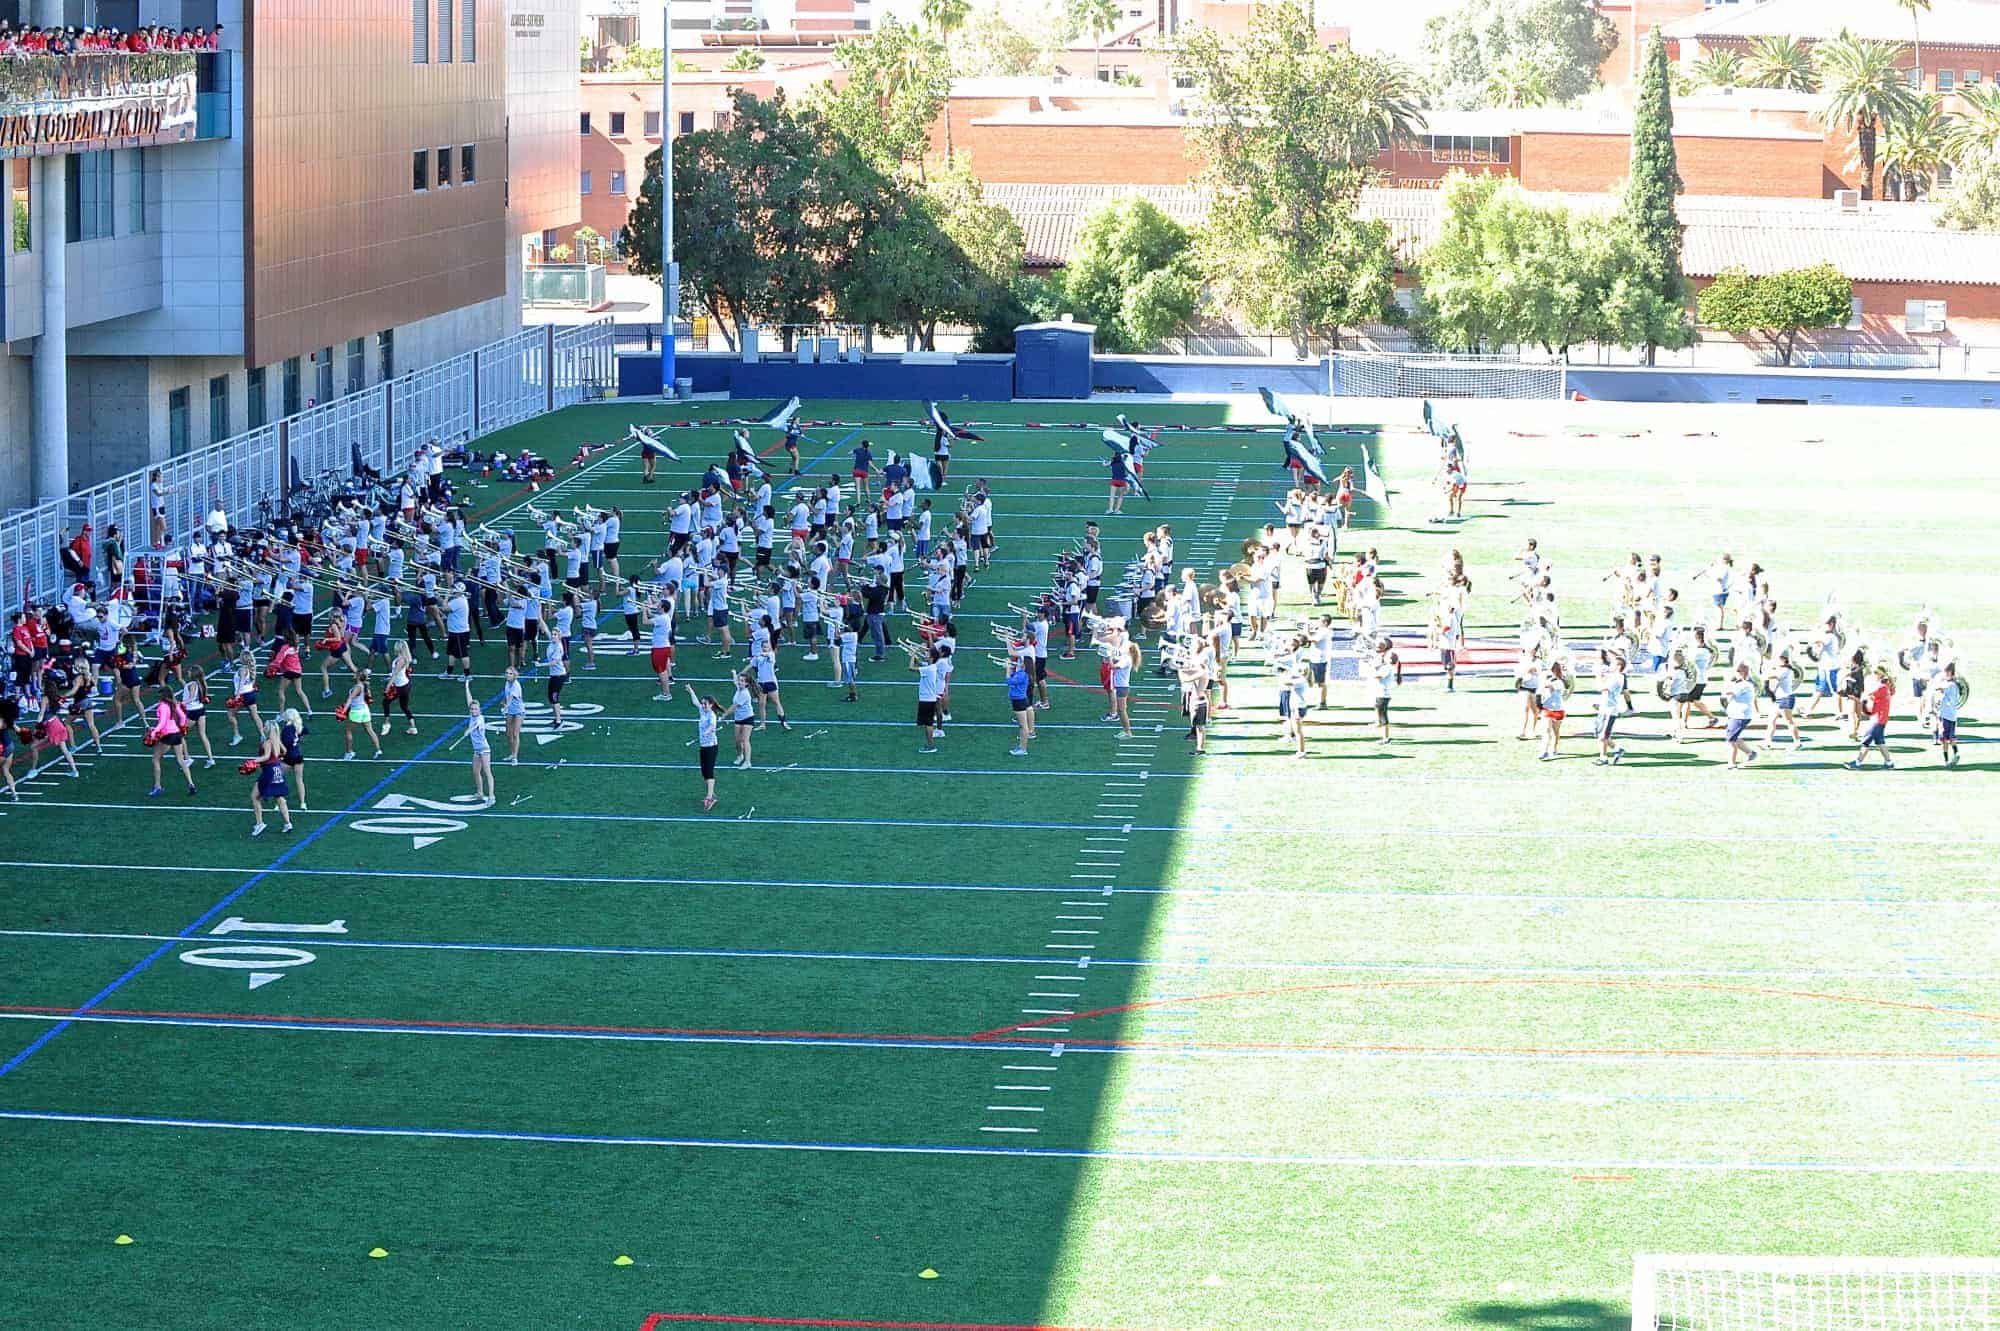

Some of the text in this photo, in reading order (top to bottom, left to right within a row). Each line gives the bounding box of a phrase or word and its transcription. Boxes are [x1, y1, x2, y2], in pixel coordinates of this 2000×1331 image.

[34, 109, 107, 143] FOOTBALL
[107, 104, 166, 137] FACILITY
[349, 794, 496, 834] 20
[178, 916, 350, 969] 10
